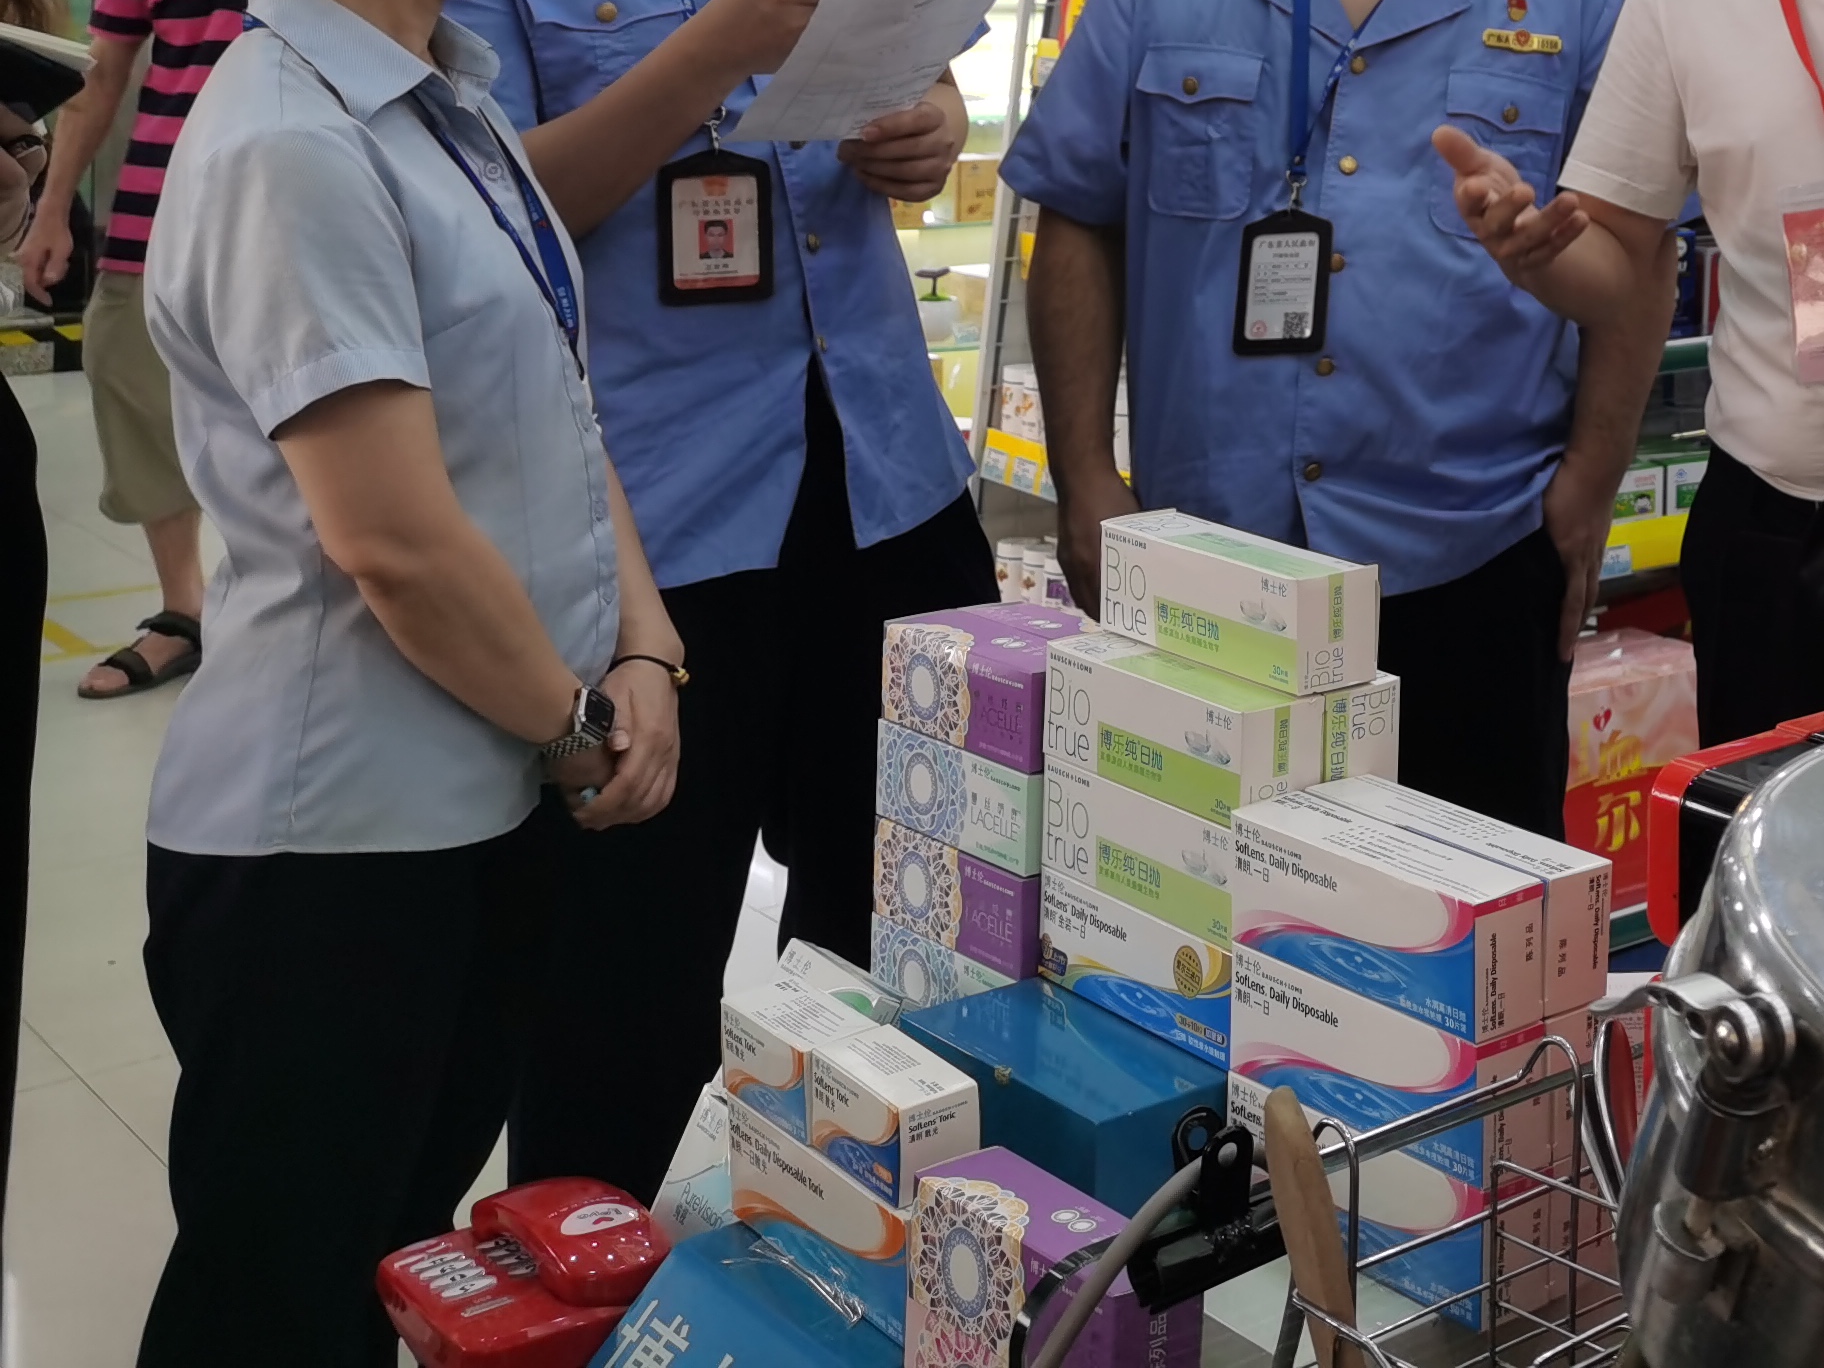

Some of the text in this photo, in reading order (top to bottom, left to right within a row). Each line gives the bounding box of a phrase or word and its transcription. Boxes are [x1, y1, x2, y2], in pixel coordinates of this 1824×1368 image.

[1105, 544, 1146, 601] Bio
[1260, 576, 1287, 598] 博士伦
[1104, 590, 1147, 636] true
[1311, 650, 1330, 688] Bio
[1333, 647, 1344, 683] true
[1049, 666, 1091, 726] Bio
[1369, 687, 1391, 736] Bio
[1205, 707, 1232, 731] 博士伦
[1352, 692, 1367, 740] true
[1048, 713, 1090, 762] true
[970, 805, 1019, 842] LACELLE
[1047, 777, 1089, 839] Bio
[1046, 824, 1089, 875] true
[1202, 827, 1229, 851] 博士伦
[1235, 820, 1261, 844] 博士伦
[1269, 854, 1289, 877] Daily
[1292, 863, 1338, 892] Disposable
[965, 905, 1013, 944] LACELLE
[1071, 904, 1088, 925] Daily
[1089, 914, 1127, 943] Disposable
[784, 948, 813, 976] 博士伦
[1235, 951, 1262, 977] 博士伦
[1558, 939, 1567, 978] 陈列品
[1269, 987, 1290, 1010] Daily
[1292, 996, 1339, 1028] Disposable
[742, 1036, 757, 1057] Toric
[836, 1087, 850, 1108] Toric
[1231, 1081, 1259, 1106] 博士伦
[908, 1109, 932, 1124] 博士伦
[939, 1111, 956, 1123] Toric
[755, 1138, 772, 1164] Daily
[772, 1152, 807, 1190] Disposable
[807, 1177, 825, 1201] Toric
[682, 1182, 725, 1230] PureVision
[1150, 1313, 1168, 1368] 列品
